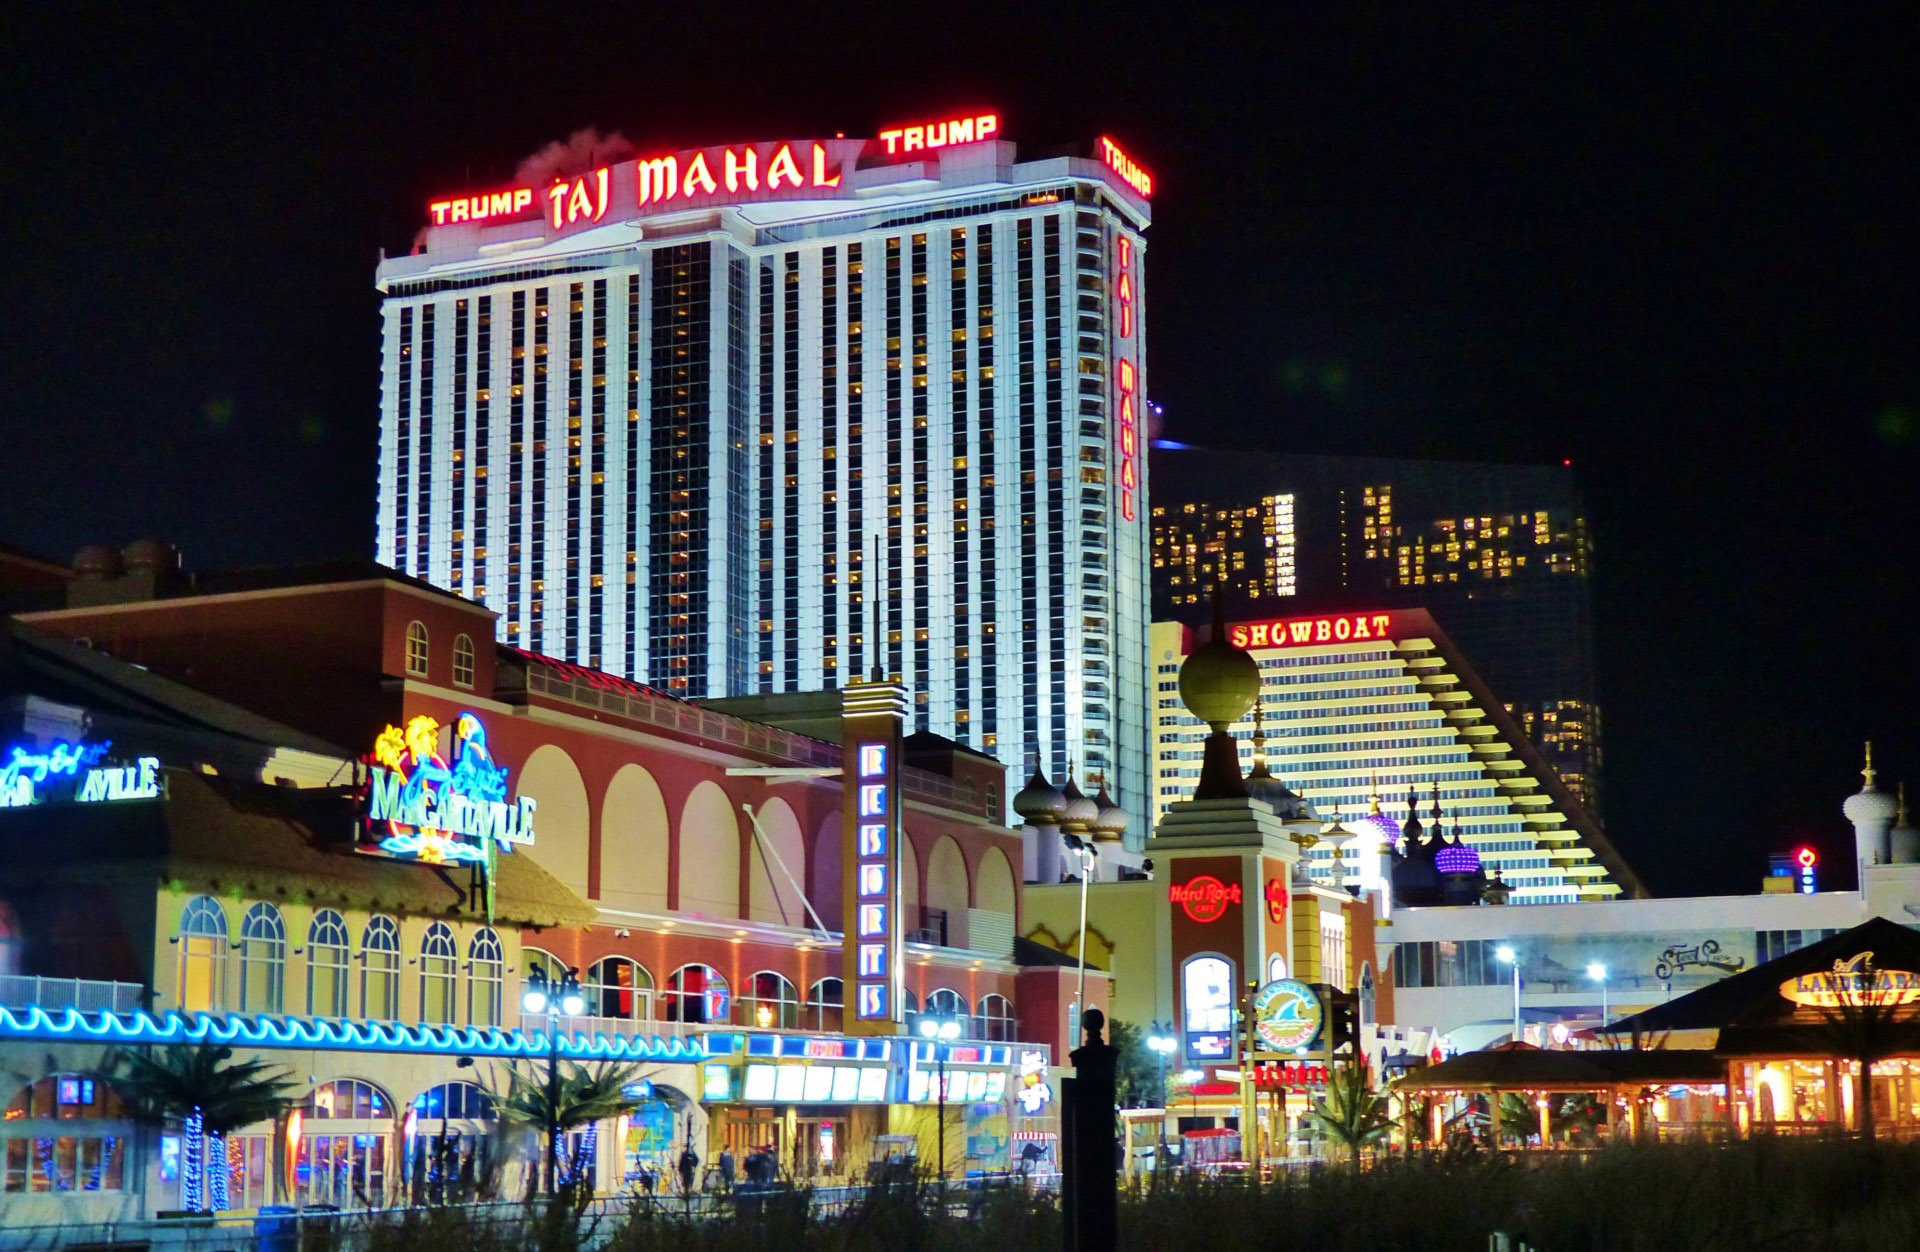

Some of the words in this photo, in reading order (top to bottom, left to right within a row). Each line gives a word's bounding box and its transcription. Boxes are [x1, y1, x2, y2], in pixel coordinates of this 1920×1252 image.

[880, 114, 997, 155] TRUMP
[549, 167, 608, 230] TAJ
[638, 143, 842, 209] MAHAL
[1102, 135, 1151, 197] TRUMP
[431, 189, 532, 225] TRUMP
[1117, 236, 1131, 339] TAJ
[1119, 357, 1136, 523] MAHAL
[1232, 614, 1390, 648] SHOWBOAT
[864, 747, 885, 1015] RESORTS
[1169, 885, 1206, 903] Hard
[1205, 883, 1242, 904] Rock
[1256, 982, 1317, 1010] LANDSHARK
[1254, 1064, 1329, 1087] RESORTS
